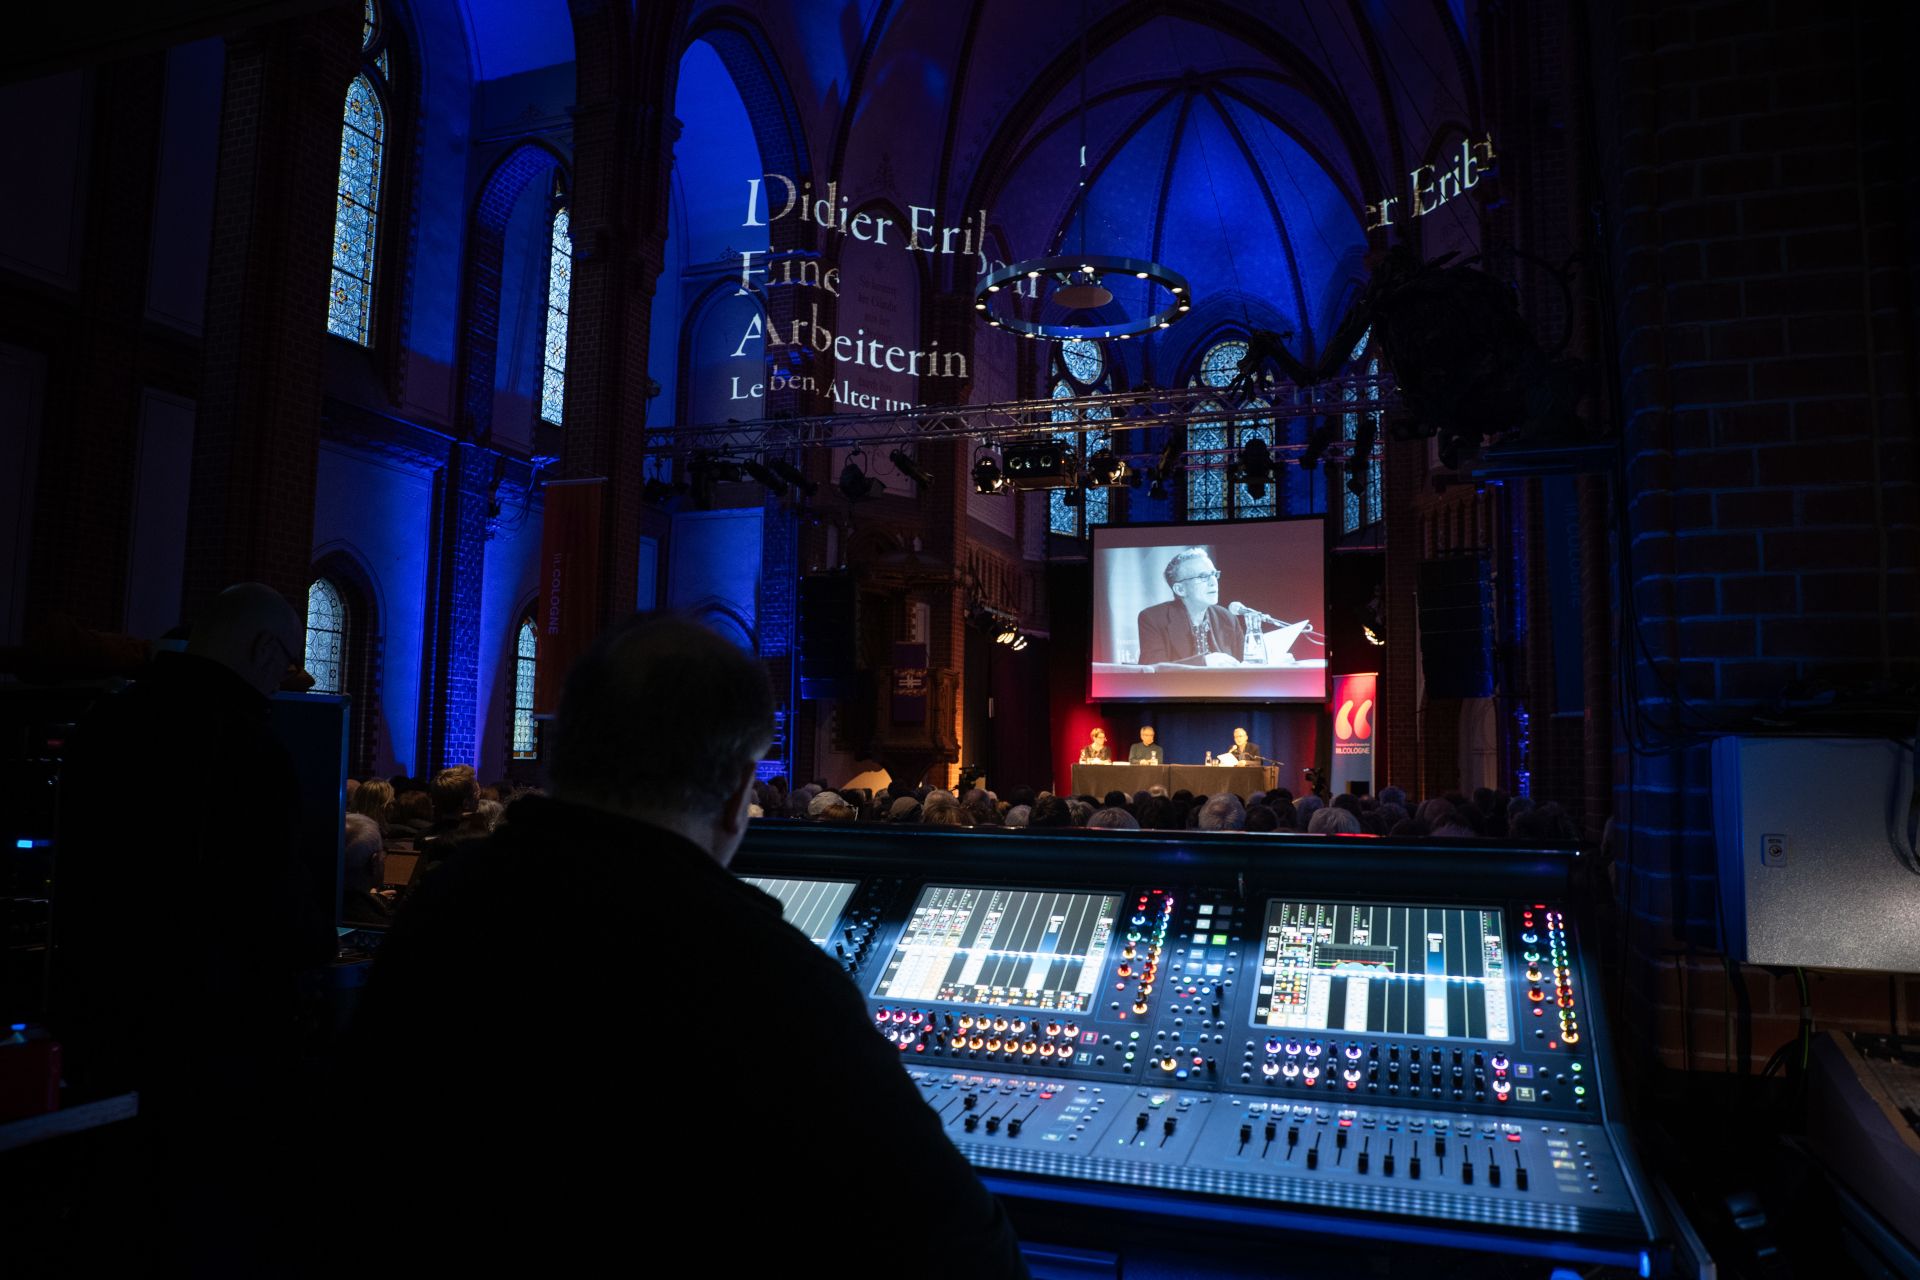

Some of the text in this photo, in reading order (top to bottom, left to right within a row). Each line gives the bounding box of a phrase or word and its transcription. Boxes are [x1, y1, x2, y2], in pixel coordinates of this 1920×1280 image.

[741, 173, 892, 245] Didier
[733, 245, 840, 298] Eine
[730, 303, 969, 378] Arbeiterin
[730, 364, 820, 400] Leben,
[824, 377, 881, 411] Alter
[885, 399, 927, 417] un
